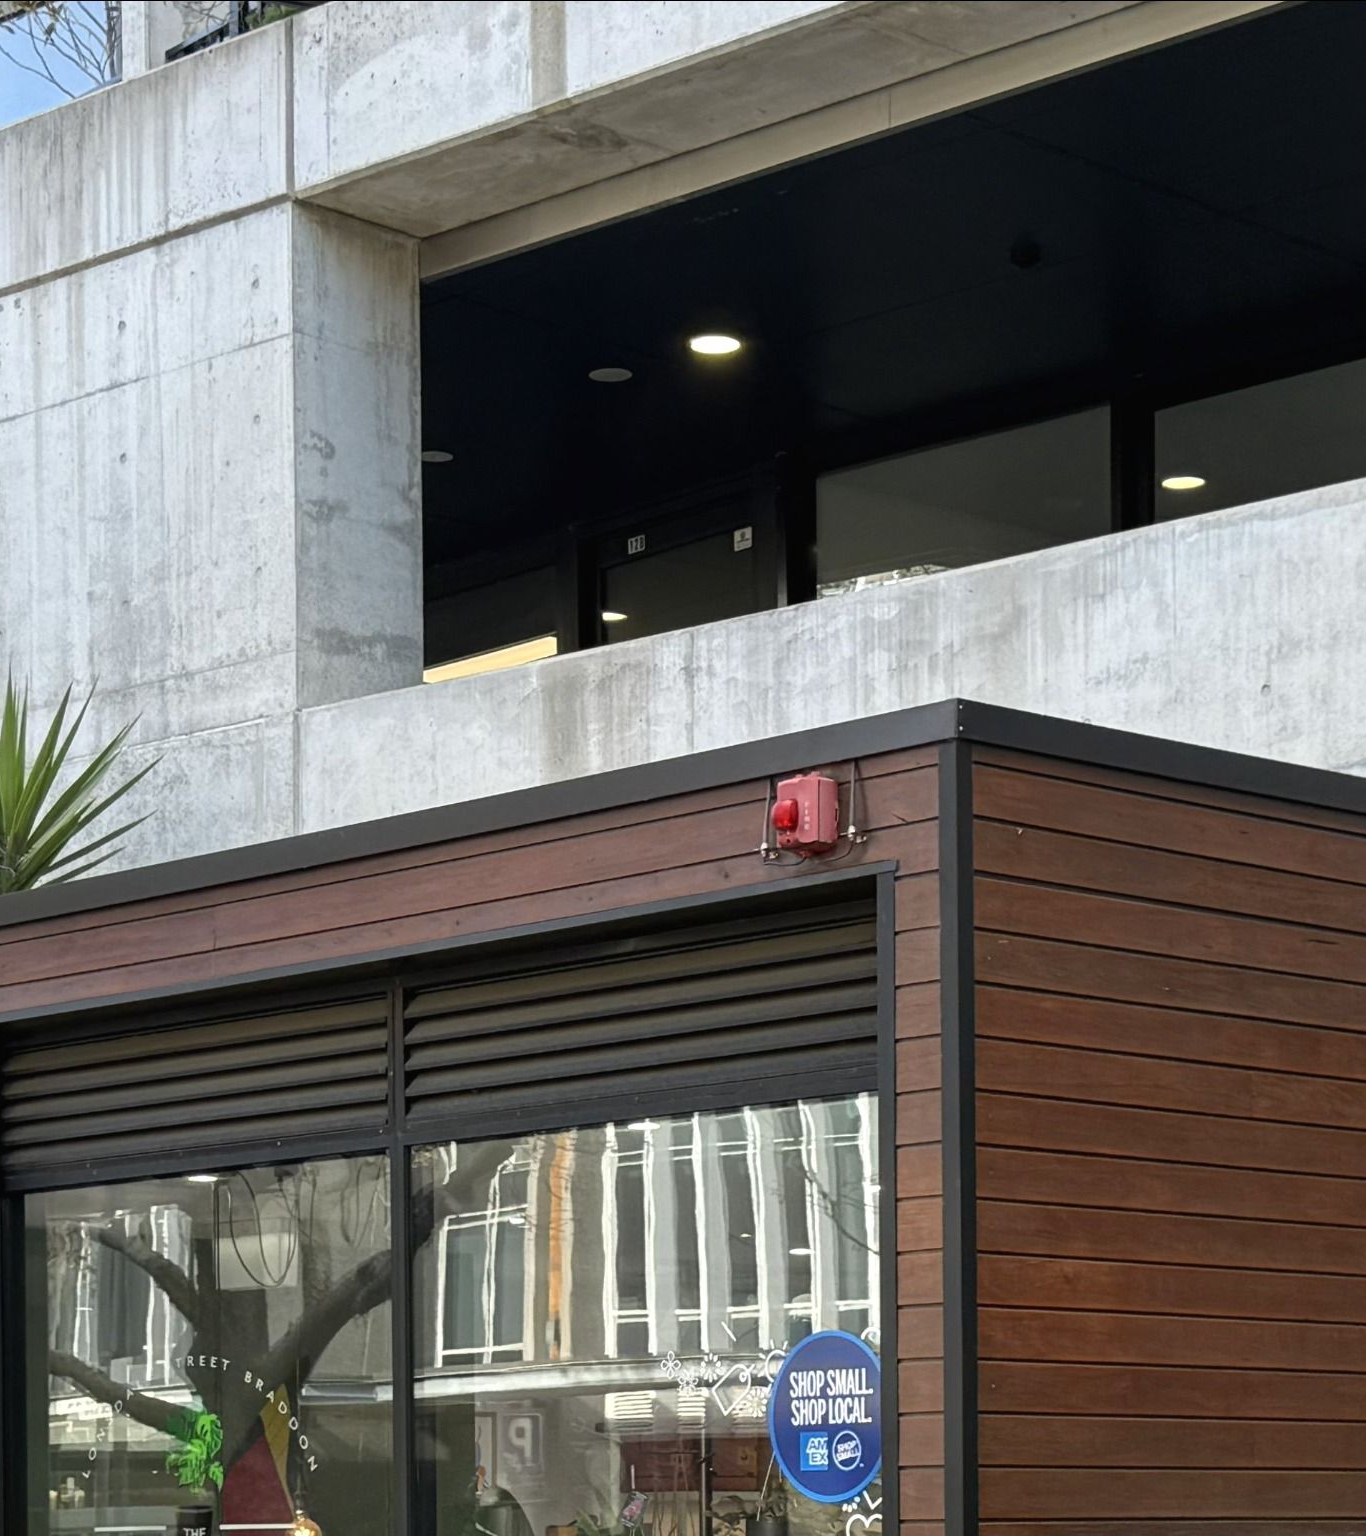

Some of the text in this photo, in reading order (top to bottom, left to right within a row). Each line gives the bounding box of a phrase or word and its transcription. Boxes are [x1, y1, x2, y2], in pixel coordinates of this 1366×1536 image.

[789, 1367, 874, 1398] SHOP SMALL.
[173, 1355, 231, 1371] TREET
[243, 1371, 319, 1473] BRADDON
[790, 1397, 873, 1426] SHOP LOCAL.
[806, 1437, 829, 1452] AM
[836, 1440, 857, 1452] SHOP
[808, 1452, 829, 1465] EX
[836, 1448, 860, 1462] SMALL
